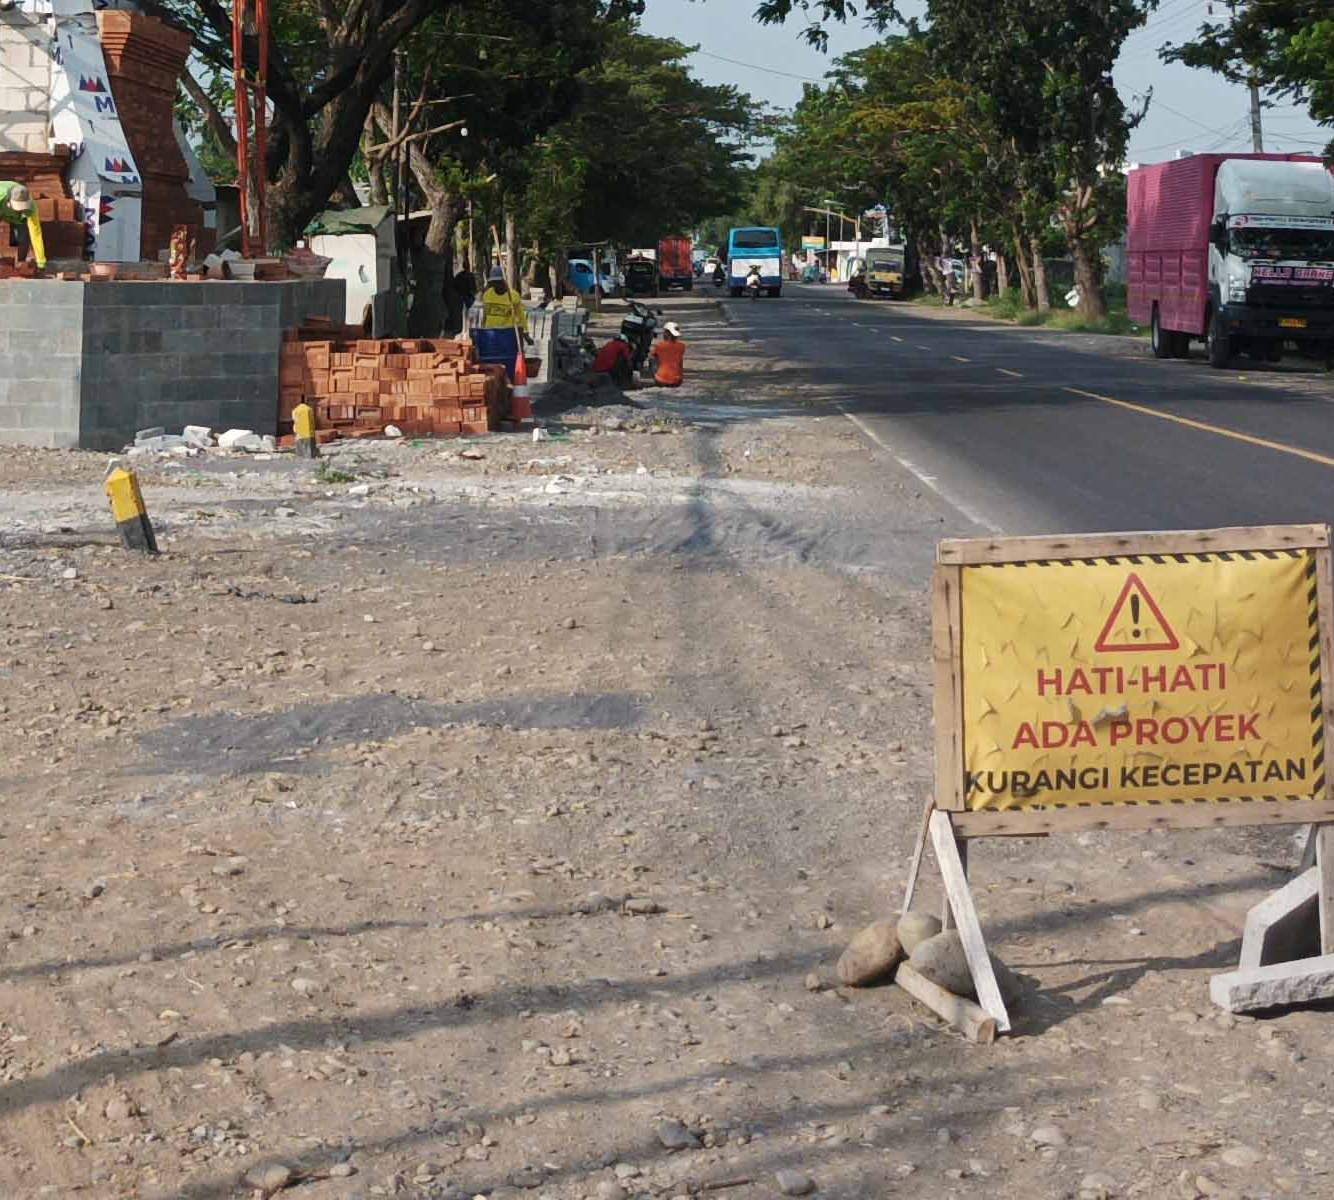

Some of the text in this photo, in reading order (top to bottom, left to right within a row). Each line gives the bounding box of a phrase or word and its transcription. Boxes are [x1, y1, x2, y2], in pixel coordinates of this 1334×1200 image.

[1037, 664, 1226, 696] HATI-HATI
[1012, 712, 1261, 749] ADA PROYEK
[964, 758, 1306, 795] KURANGI KECEPATAN
